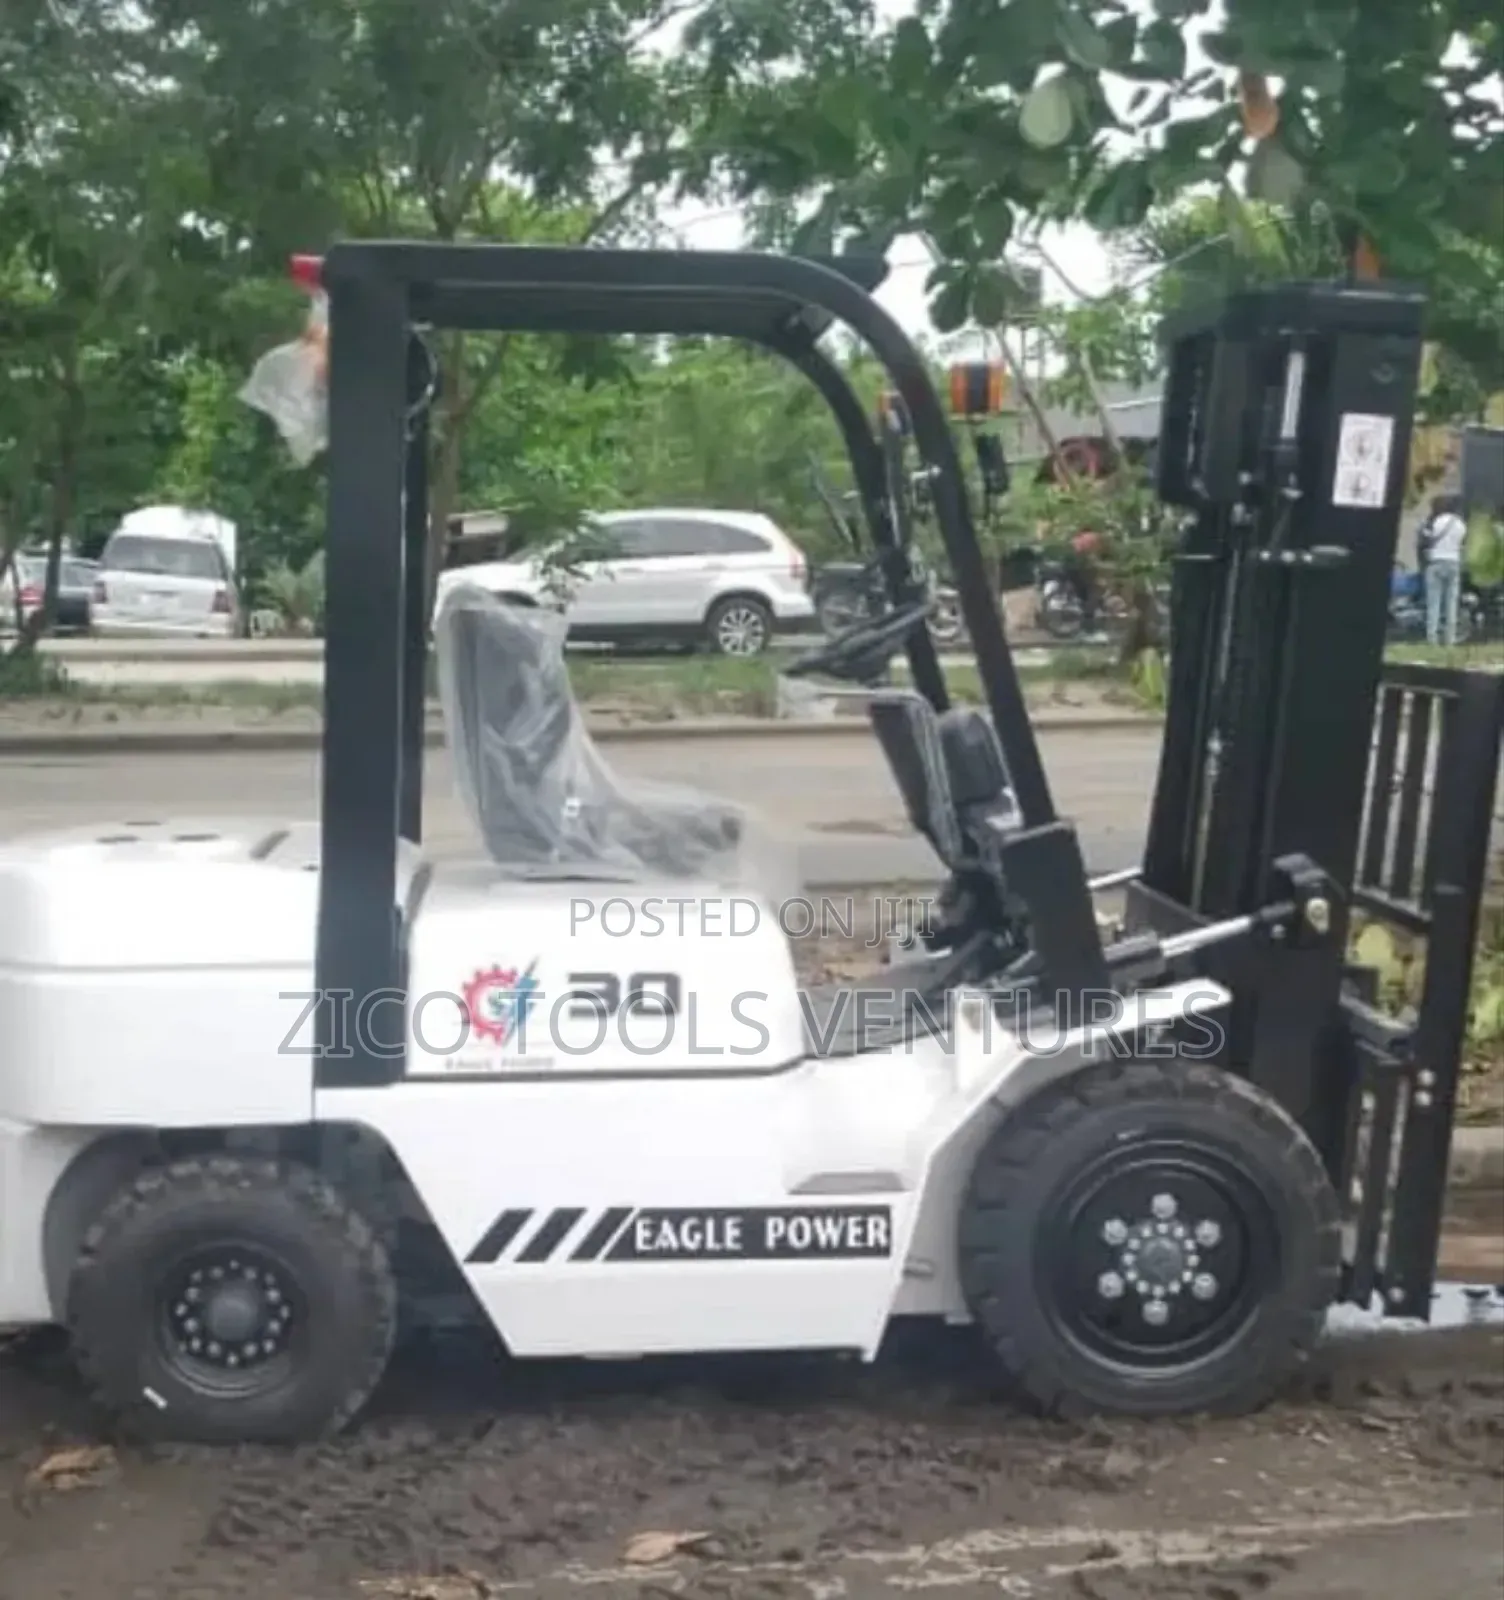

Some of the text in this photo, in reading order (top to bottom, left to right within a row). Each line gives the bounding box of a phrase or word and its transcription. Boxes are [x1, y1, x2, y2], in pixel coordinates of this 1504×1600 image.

[567, 972, 681, 1017] 30
[634, 1214, 889, 1251] EAGLE POWER
